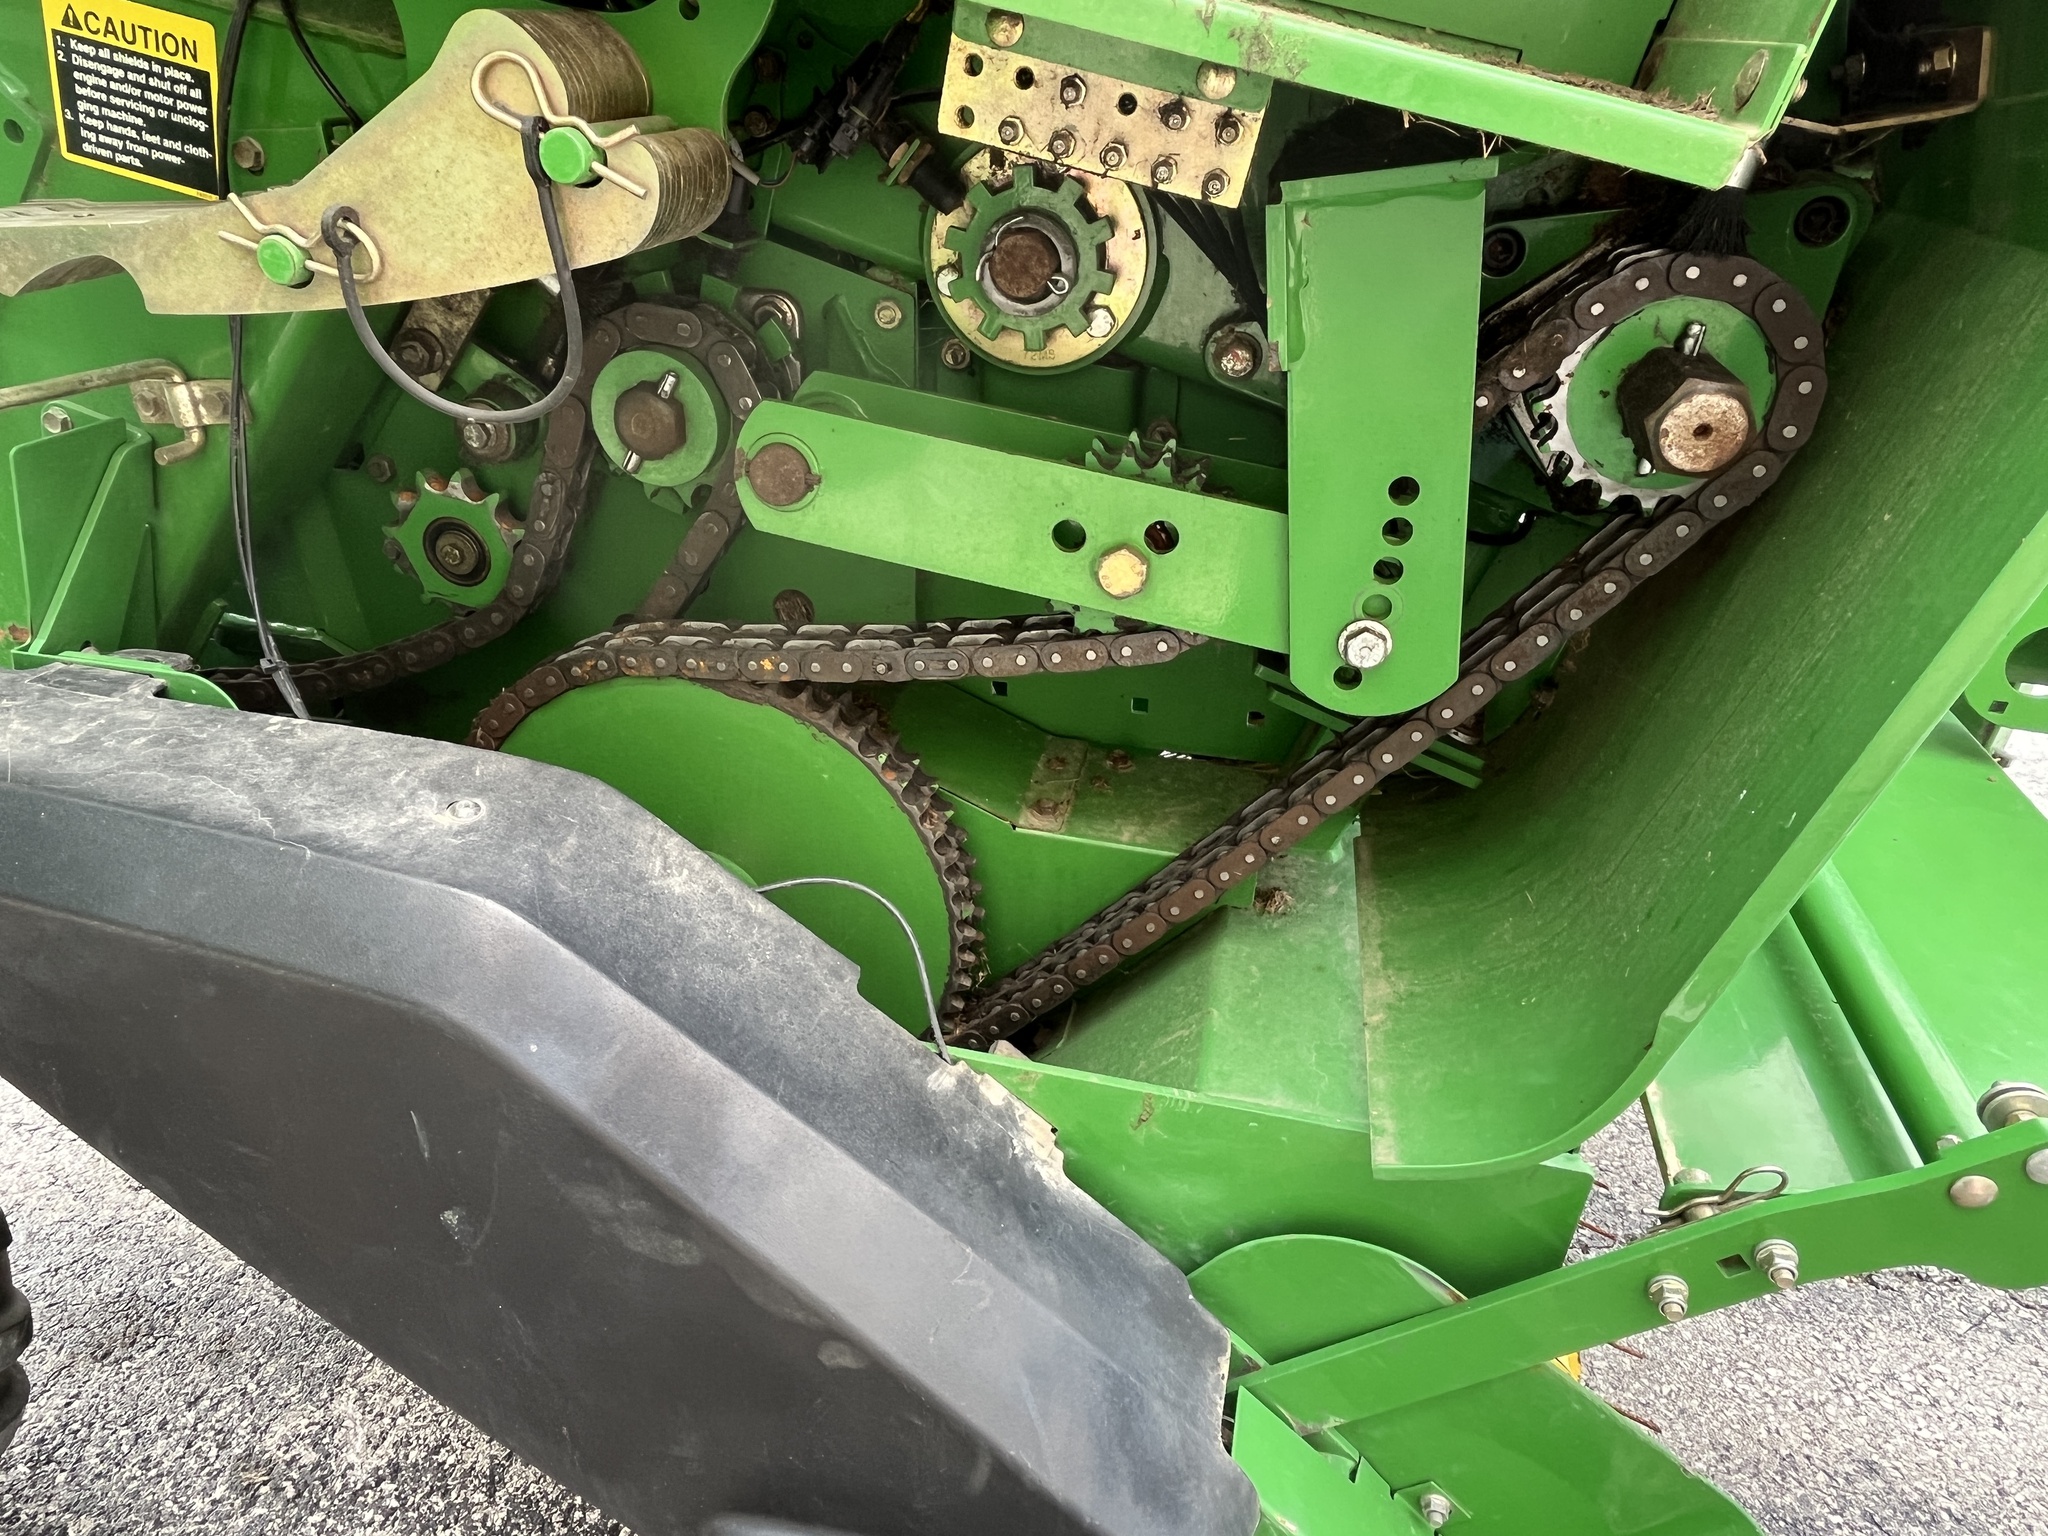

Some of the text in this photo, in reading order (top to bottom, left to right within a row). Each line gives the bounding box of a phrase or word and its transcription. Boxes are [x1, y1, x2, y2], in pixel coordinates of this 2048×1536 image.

[56, 35, 194, 83] 1. Keep all shields in place.
[84, 11, 198, 63] CAUTION
[72, 53, 125, 78] Disengage
[127, 71, 146, 84] and
[148, 76, 171, 91] shut
[173, 84, 187, 95] off
[189, 88, 202, 100] all
[73, 71, 207, 115] engine and/or motor power
[75, 83, 209, 132] before servicing or unclog-
[77, 100, 146, 127] ging machine.
[64, 109, 212, 159] 3. Keep hands, feet and cloth-
[81, 127, 185, 165] ing away from power-
[82, 142, 144, 168] driven parts.
